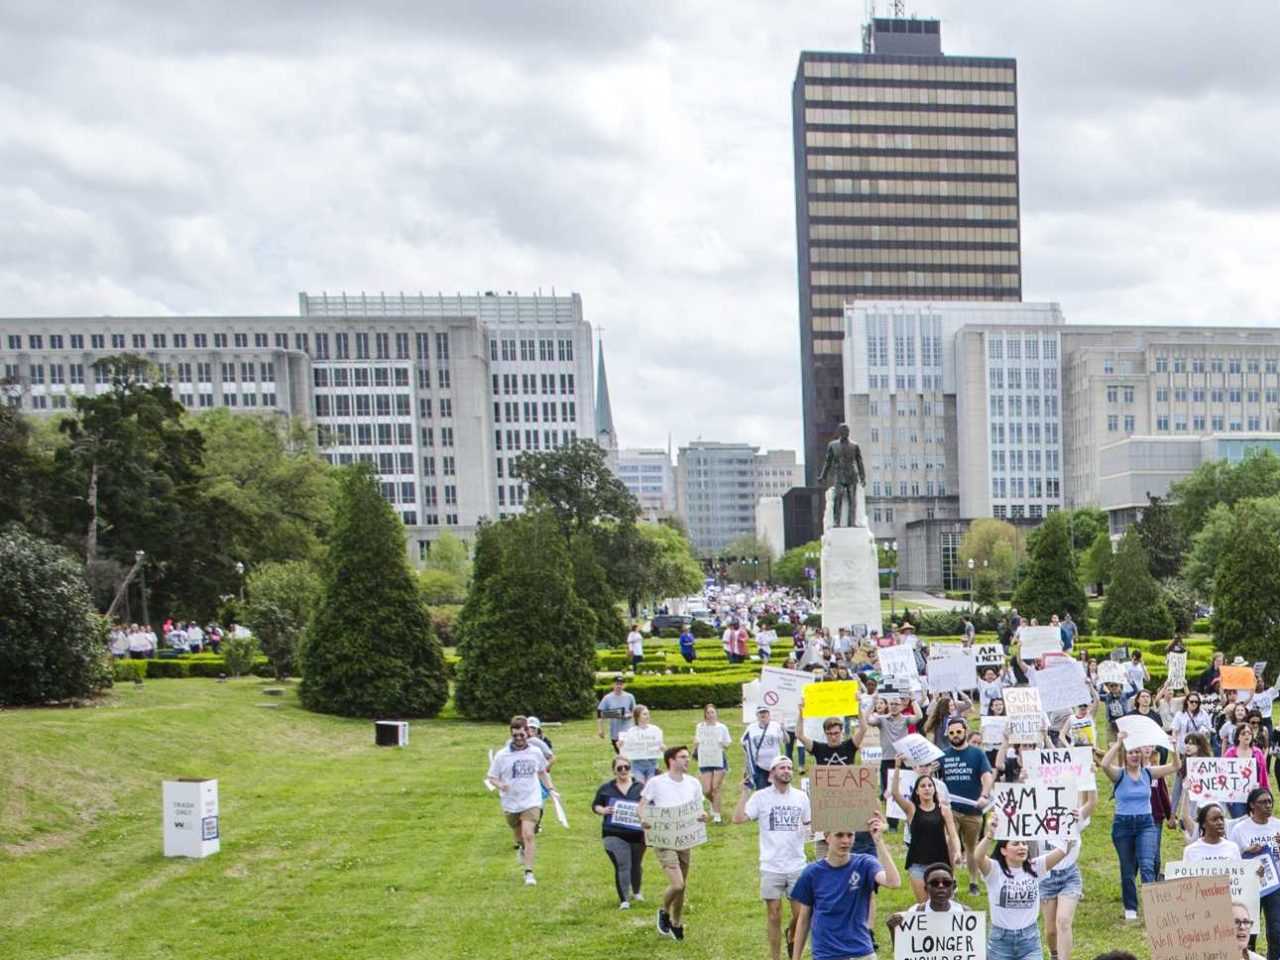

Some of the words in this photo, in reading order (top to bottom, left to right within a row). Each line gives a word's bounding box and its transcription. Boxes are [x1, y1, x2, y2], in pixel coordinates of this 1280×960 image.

[1006, 690, 1037, 703] GUN
[1041, 751, 1071, 764] NRA
[1199, 761, 1217, 774] AM
[1228, 761, 1236, 774] I
[815, 767, 875, 788] FEAR
[1008, 787, 1036, 810] AM
[1048, 787, 1065, 811] I
[1175, 867, 1246, 876] POLITICIANS
[900, 914, 927, 932] WE
[952, 914, 977, 931] NO
[912, 935, 974, 953] LONGER
